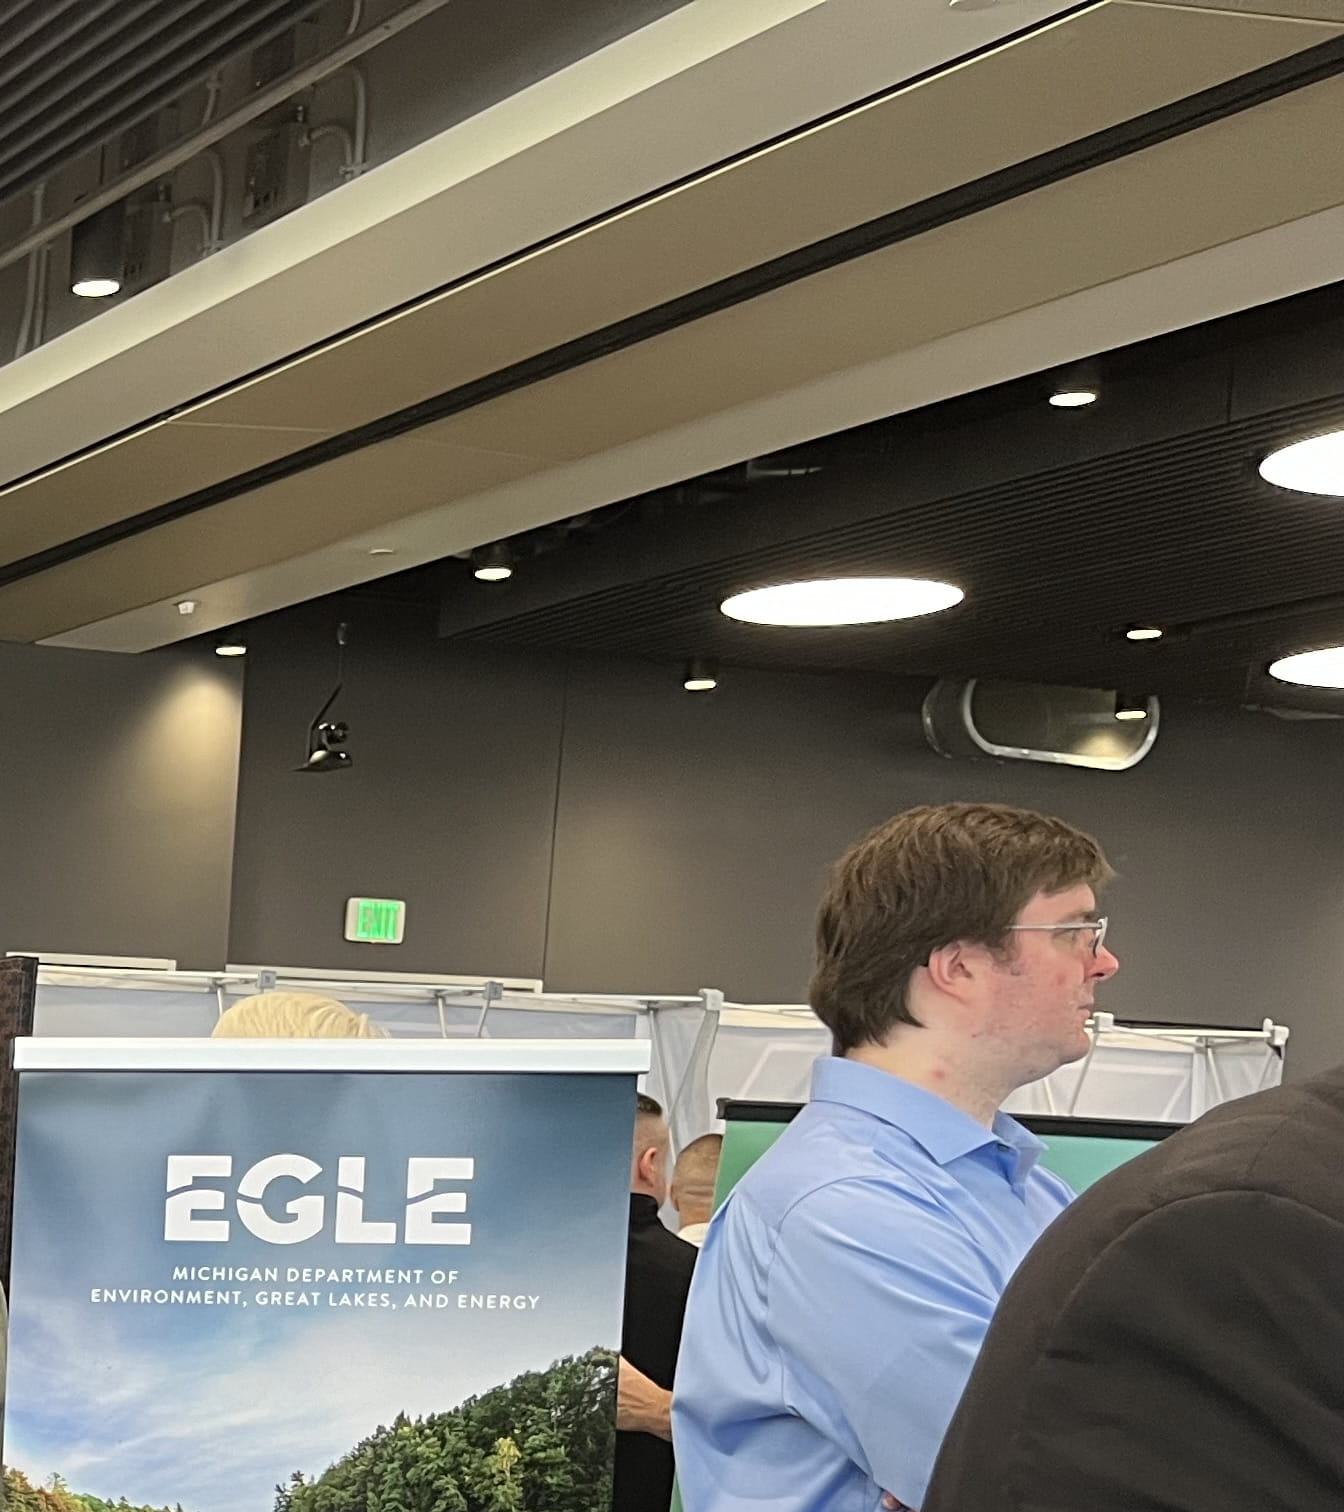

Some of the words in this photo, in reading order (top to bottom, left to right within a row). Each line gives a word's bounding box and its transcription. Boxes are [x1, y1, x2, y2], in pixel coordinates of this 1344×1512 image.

[164, 1154, 475, 1245] EGLE
[172, 1266, 279, 1285] MICHIGAN
[286, 1267, 424, 1285] DEPARTMENT
[431, 1269, 459, 1285] OF
[90, 1288, 248, 1309] ENVIRONMENT,
[255, 1290, 321, 1307] GREAT
[328, 1292, 398, 1310] LAKES,
[404, 1293, 450, 1309] AND
[457, 1294, 540, 1310] ENERGY
